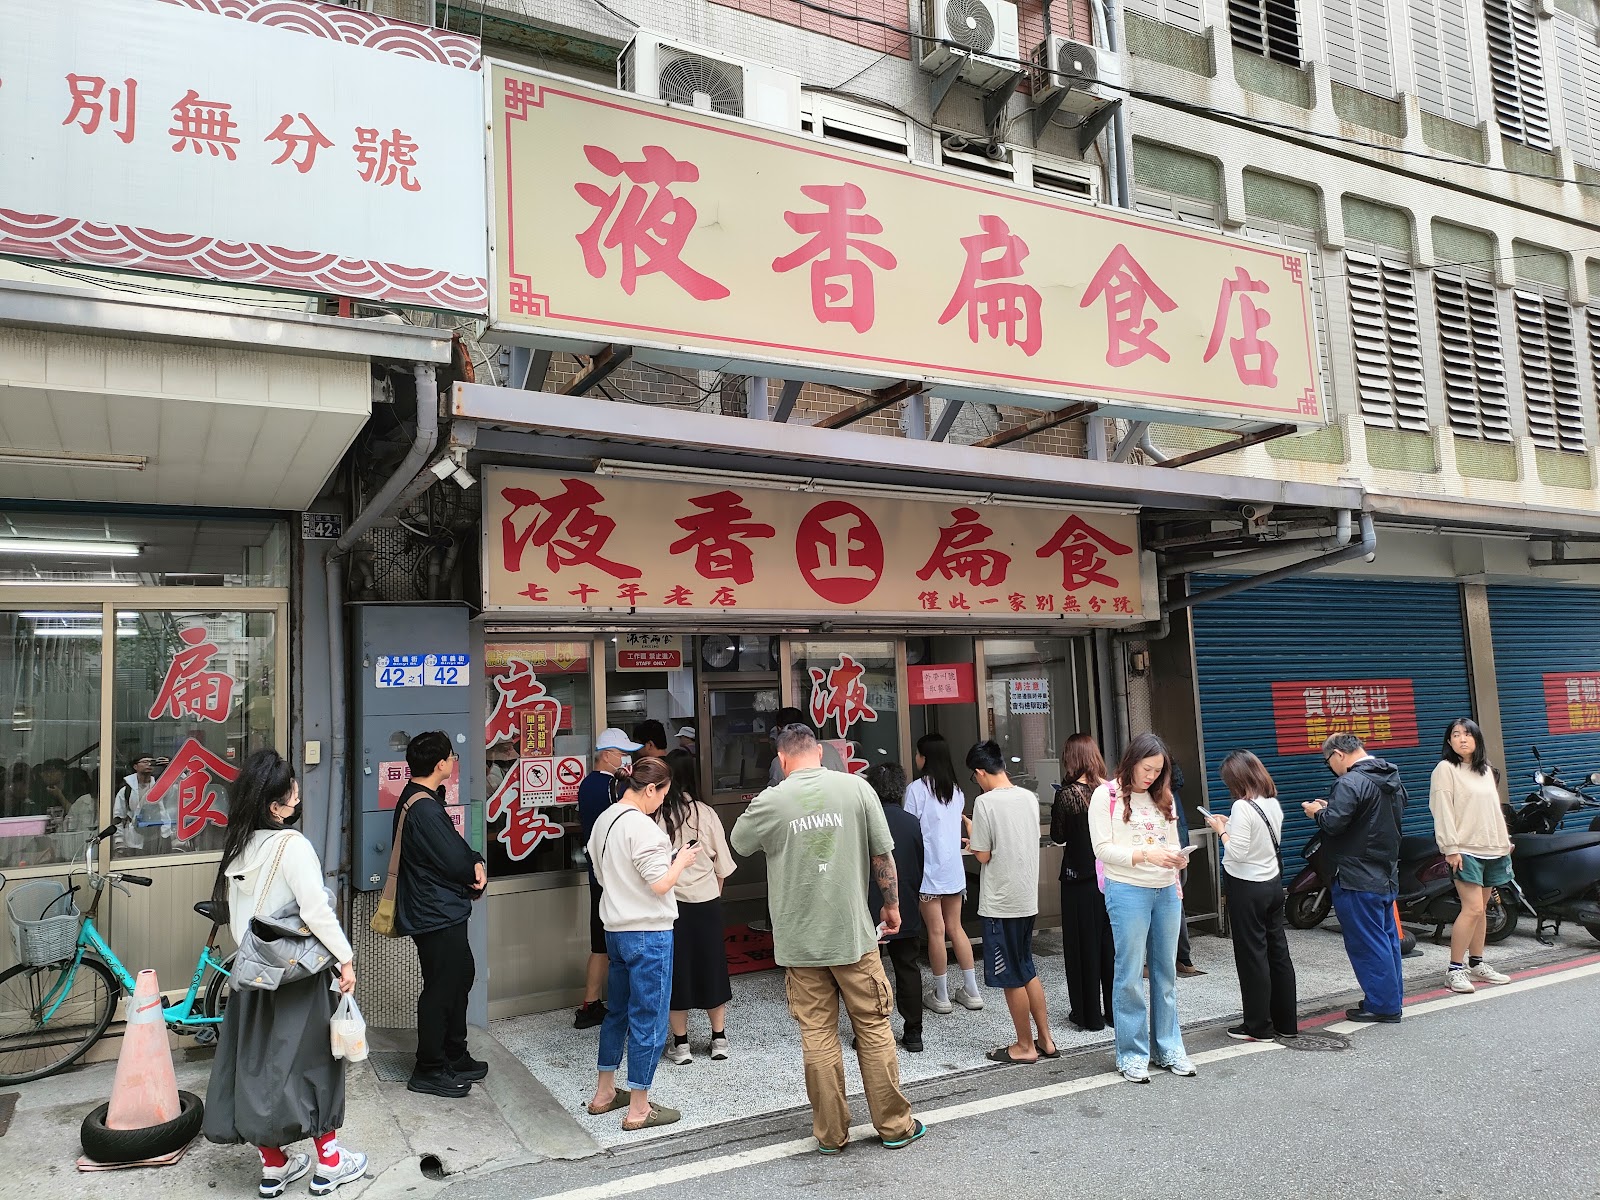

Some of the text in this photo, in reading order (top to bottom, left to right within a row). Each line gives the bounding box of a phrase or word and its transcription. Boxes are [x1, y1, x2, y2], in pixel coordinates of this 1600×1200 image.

[63, 73, 421, 192] 別無分號
[574, 144, 1280, 389] 液香扁食店
[517, 582, 737, 606] 七十年老店
[918, 591, 1134, 614] 僅此一家別無分號
[380, 668, 422, 687] 42之1
[434, 667, 458, 685] 42
[1303, 686, 1390, 717] 貨物進出
[1565, 677, 1600, 704] 貨物
[146, 627, 242, 841] 扁食
[526, 714, 535, 749] 開工大吉
[789, 812, 843, 835] TAIWAN
